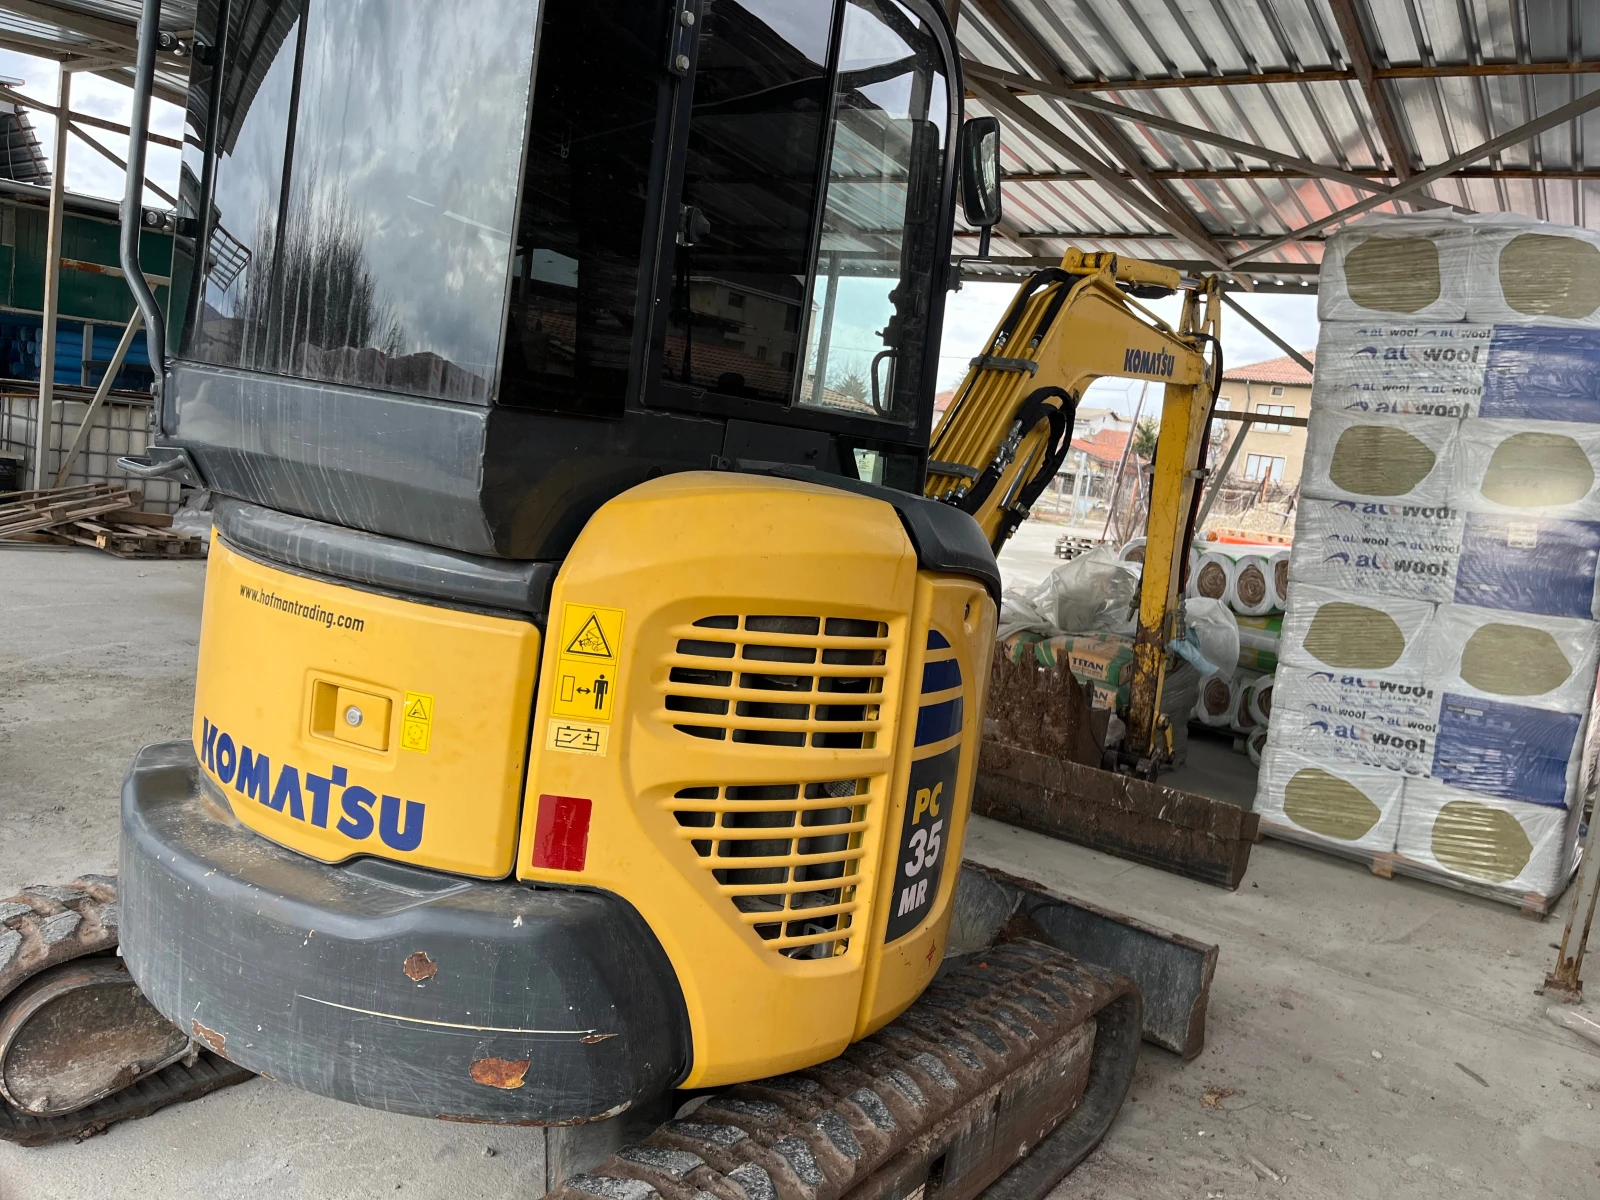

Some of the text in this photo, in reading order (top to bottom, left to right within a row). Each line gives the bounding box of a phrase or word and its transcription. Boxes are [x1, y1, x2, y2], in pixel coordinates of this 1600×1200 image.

[1389, 328, 1419, 337] wool
[1461, 329, 1491, 339] wool
[1123, 346, 1175, 377] KOMATSU
[1423, 345, 1480, 363] wool
[1452, 386, 1482, 396] wool
[1414, 402, 1470, 419] wool
[1402, 505, 1458, 520] wool
[1361, 537, 1389, 546] wool
[1430, 544, 1460, 554] wool
[1394, 559, 1449, 577] wool
[240, 583, 365, 633] www.hofmantrading.com
[1071, 656, 1105, 672] TITAN
[1379, 680, 1434, 699] wool
[1338, 708, 1367, 720] wool
[1407, 719, 1437, 733] wool
[1372, 733, 1427, 754] wool
[201, 715, 426, 852] KOMATSU
[911, 781, 944, 826] PC
[904, 818, 944, 878] 35
[897, 878, 929, 918] MR
